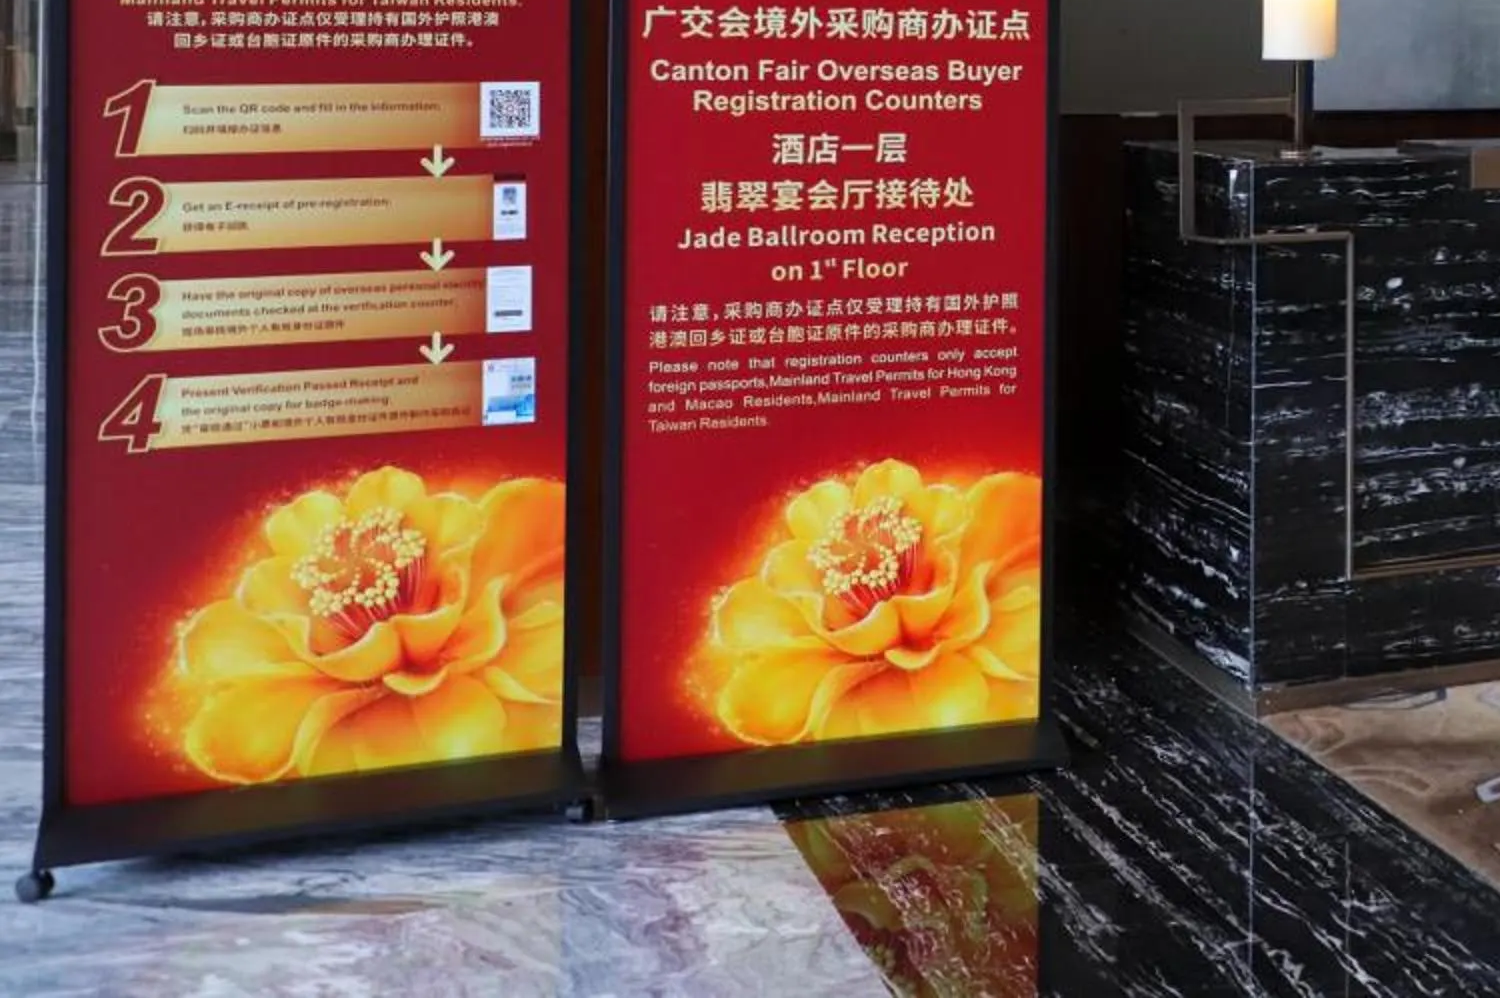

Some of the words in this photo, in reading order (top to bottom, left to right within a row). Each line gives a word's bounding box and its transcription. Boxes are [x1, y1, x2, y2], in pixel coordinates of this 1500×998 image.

[642, 5, 1030, 40] 广交会境外采购商办证点
[650, 59, 749, 82] Canton
[758, 59, 810, 81] Fair
[817, 59, 940, 82] Overseas
[948, 59, 1023, 87] Buyer
[182, 104, 214, 115] Scan
[216, 105, 236, 114] the
[239, 103, 258, 114] QR
[261, 104, 291, 114] code
[293, 103, 316, 113] and
[318, 102, 334, 113] fill
[335, 104, 347, 112] in
[348, 102, 368, 112] the
[693, 89, 857, 117] Registration
[865, 89, 983, 111] Counters
[103, 79, 157, 157] 1
[772, 132, 907, 165] 酒店一层
[182, 202, 204, 214] Get
[208, 204, 222, 212] an
[224, 200, 280, 214] E-receipt
[282, 198, 294, 210] of
[701, 176, 974, 213] 翡翠宴会厅接待处
[100, 176, 168, 256] 2
[677, 226, 742, 249] Jade
[747, 225, 866, 247] Ballroom
[872, 221, 995, 247] Reception
[771, 264, 804, 282] on
[810, 257, 837, 280] 1st
[842, 257, 909, 279] Floor
[181, 292, 213, 302] Have
[215, 291, 236, 301] the
[238, 287, 285, 301] original
[287, 288, 317, 300] copy
[318, 285, 332, 296] of
[333, 285, 387, 295] overseas
[98, 273, 162, 352] 3
[181, 307, 251, 320] documents
[252, 304, 305, 316] checked
[307, 304, 319, 313] at
[320, 303, 340, 313] the
[342, 300, 408, 312] verification
[648, 361, 699, 374] Please
[707, 359, 740, 371] note
[748, 356, 776, 370] that
[784, 353, 863, 370] registration
[870, 351, 929, 364] counters
[937, 348, 966, 363] only
[973, 345, 1018, 360] accept
[180, 386, 230, 399] Present
[231, 383, 302, 396] Verification
[303, 379, 348, 392] Passed
[349, 377, 395, 389] Receipt
[396, 375, 420, 386] and
[648, 380, 697, 395] foreign
[832, 370, 874, 384] Travel
[875, 369, 926, 382] Permits
[926, 367, 946, 380] for
[947, 366, 982, 381] Hong
[983, 365, 1017, 379] Kong
[180, 407, 201, 417] the
[203, 404, 251, 417] original
[252, 402, 282, 414] copy
[285, 400, 303, 410] for
[647, 399, 676, 413] and
[684, 398, 734, 411] Macao
[890, 386, 932, 400] Travel
[939, 383, 991, 398] Permits
[999, 383, 1017, 395] for
[98, 373, 168, 453] 4
[648, 419, 697, 433] Taiwan
